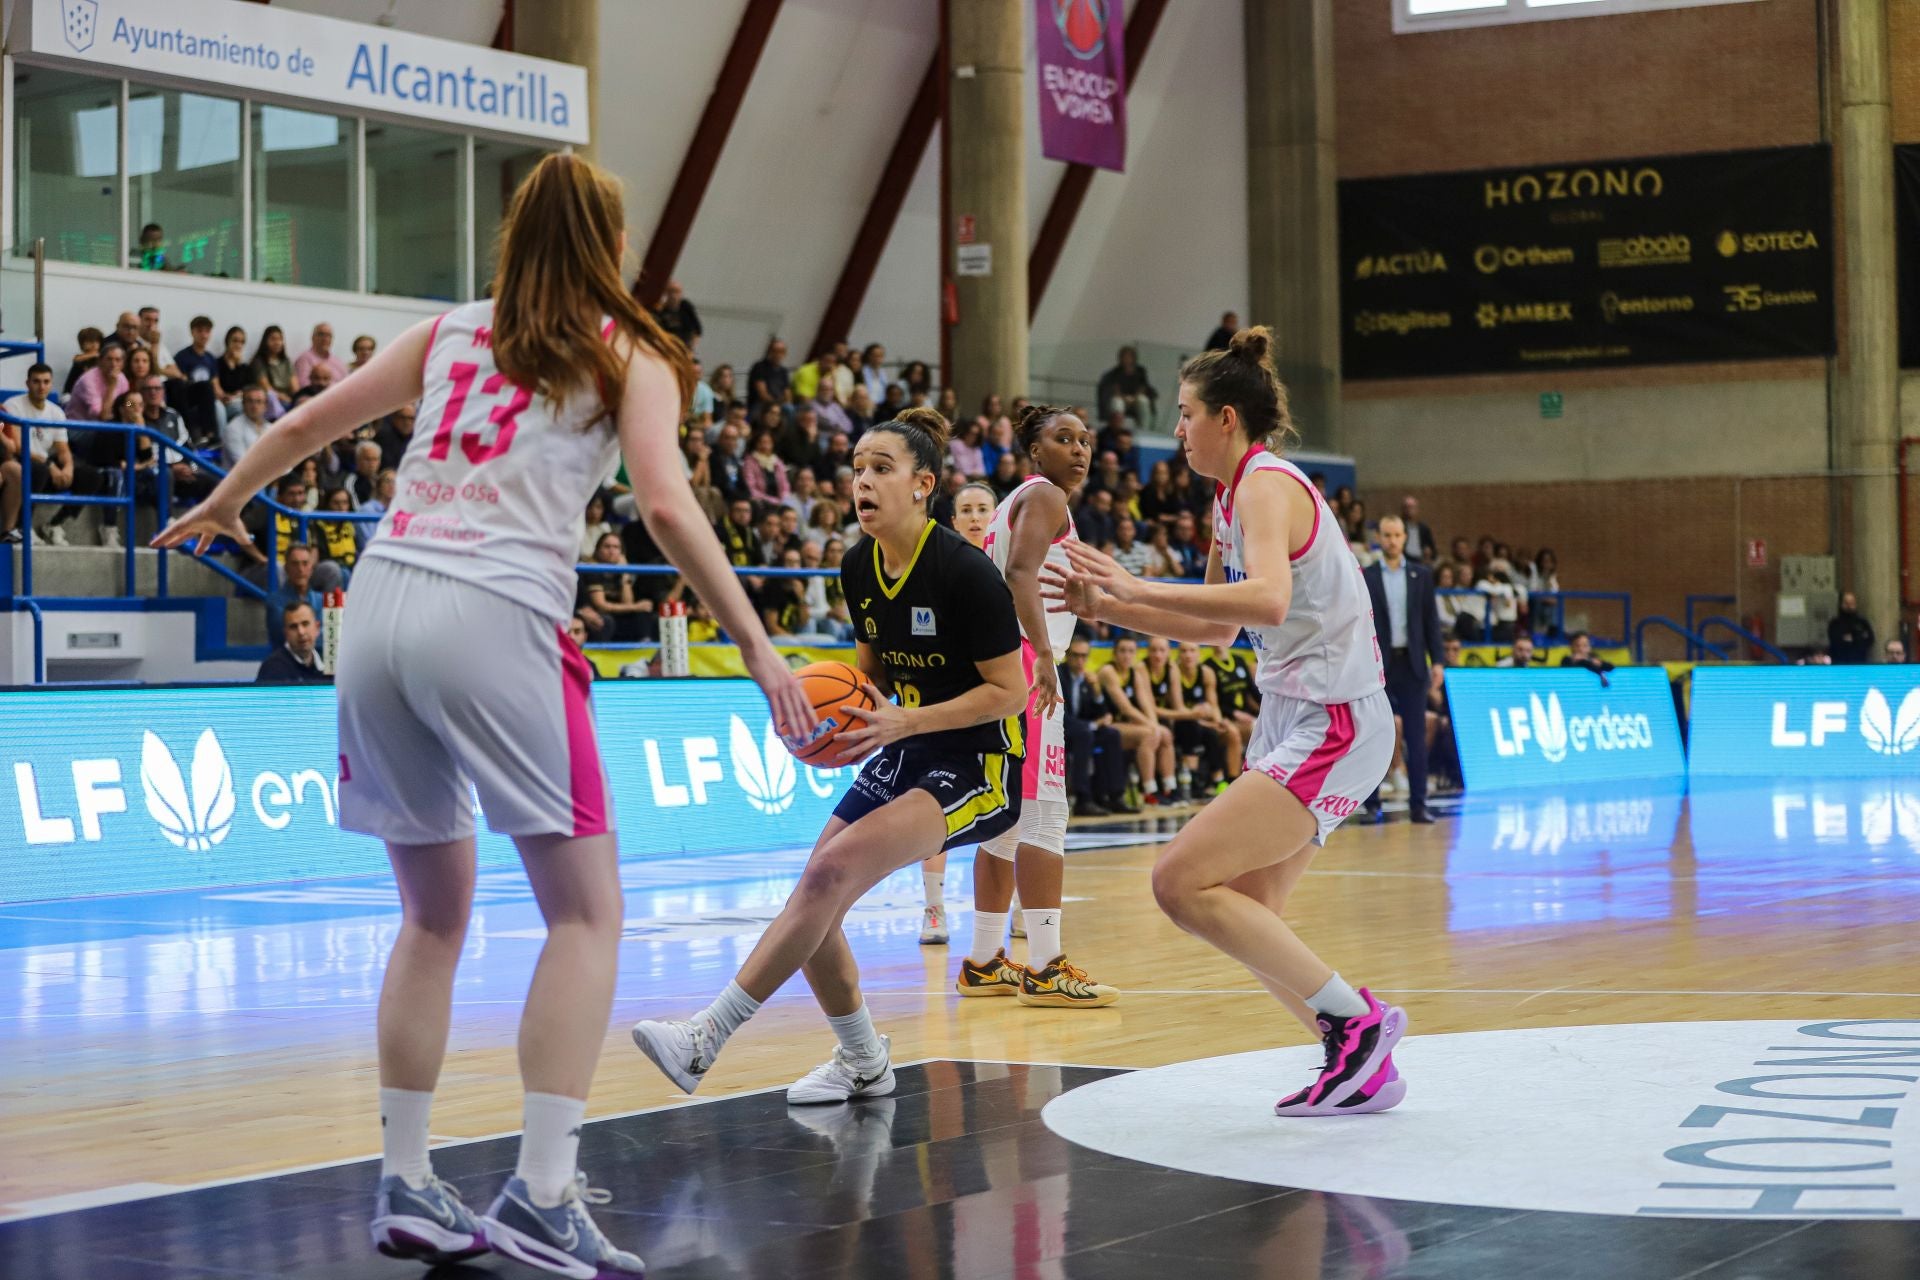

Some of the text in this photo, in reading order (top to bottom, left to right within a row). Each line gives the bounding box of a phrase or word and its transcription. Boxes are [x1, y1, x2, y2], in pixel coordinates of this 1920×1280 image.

[112, 16, 570, 127] Ayuntamiento de Alcantarilla
[1051, 91, 1114, 125] WOMEN
[1484, 167, 1664, 209] HOZONO
[1503, 245, 1574, 268] Orthem
[1742, 230, 1819, 253] SOTECA
[1502, 302, 1573, 324] AMBEX
[1619, 293, 1696, 315] entorno
[429, 362, 534, 466] 13
[1490, 705, 1653, 756] LF endesa
[1771, 702, 1848, 747] LF
[643, 737, 723, 807] LF
[13, 758, 128, 845] LF
